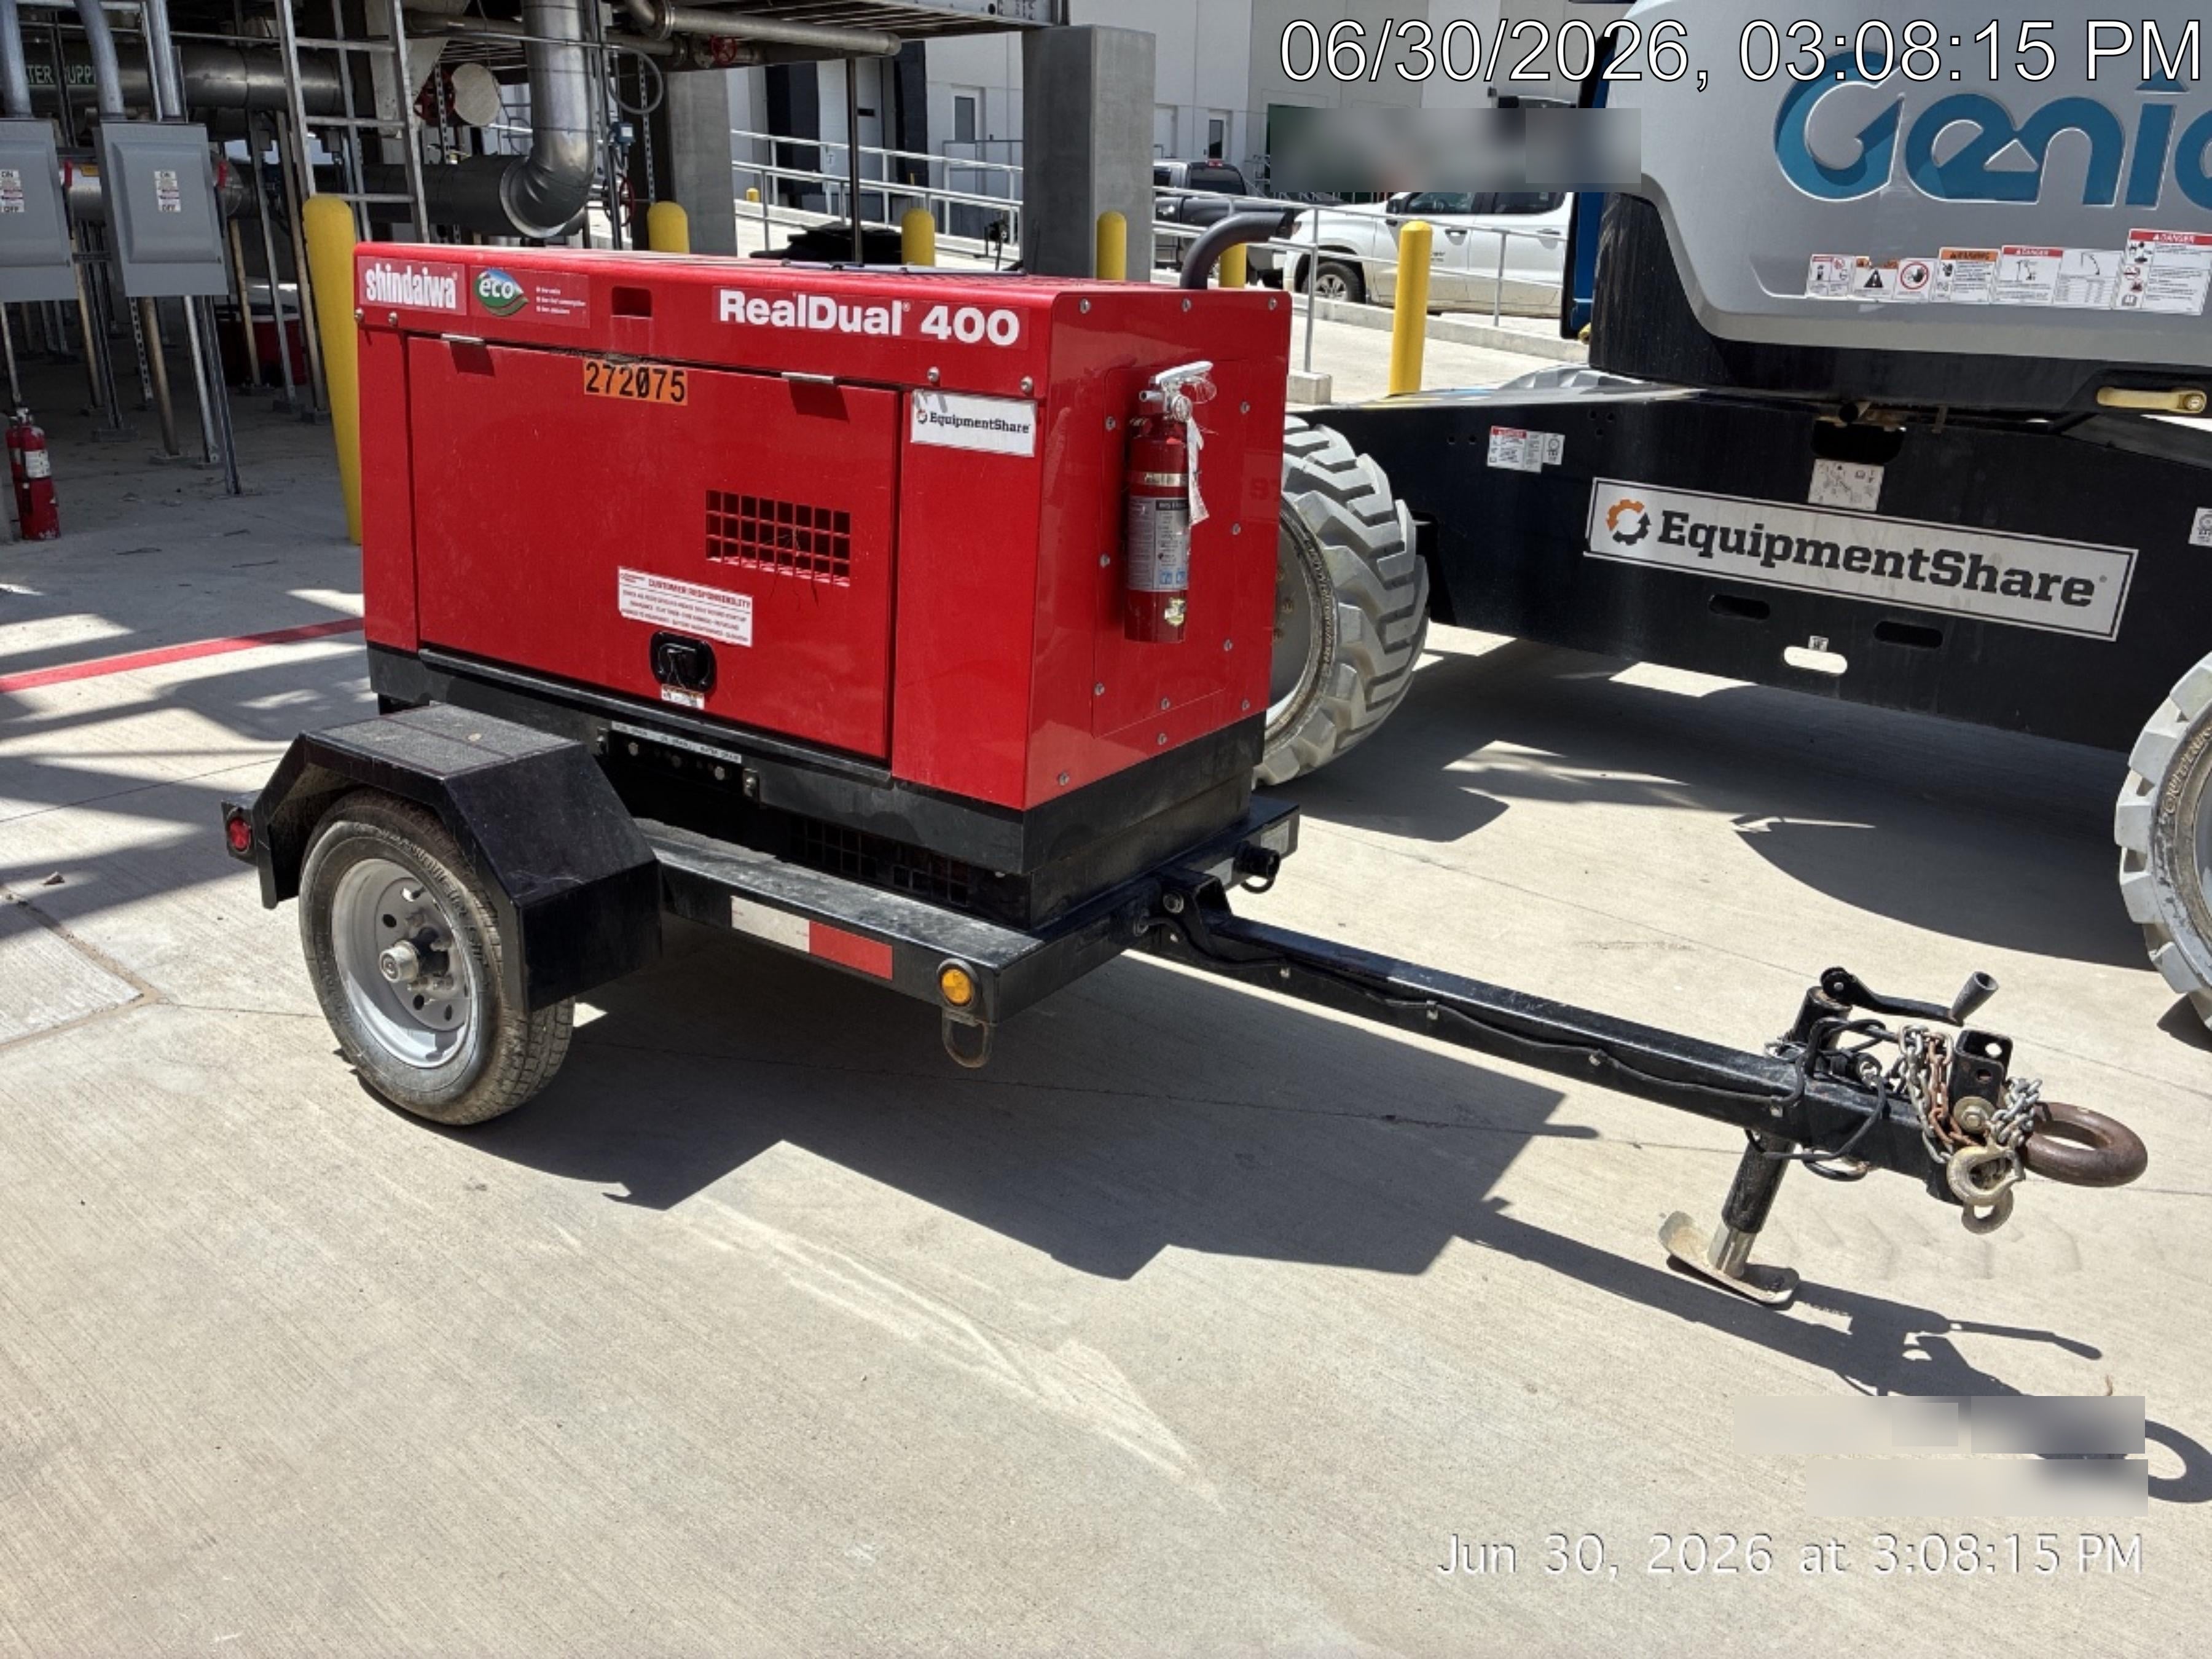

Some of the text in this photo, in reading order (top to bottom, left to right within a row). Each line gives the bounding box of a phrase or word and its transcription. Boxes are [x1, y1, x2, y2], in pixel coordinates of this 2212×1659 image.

[1774, 49, 2212, 213] Geni
[478, 280, 515, 300] eco
[921, 305, 1020, 346] 400
[586, 361, 685, 402] 272075
